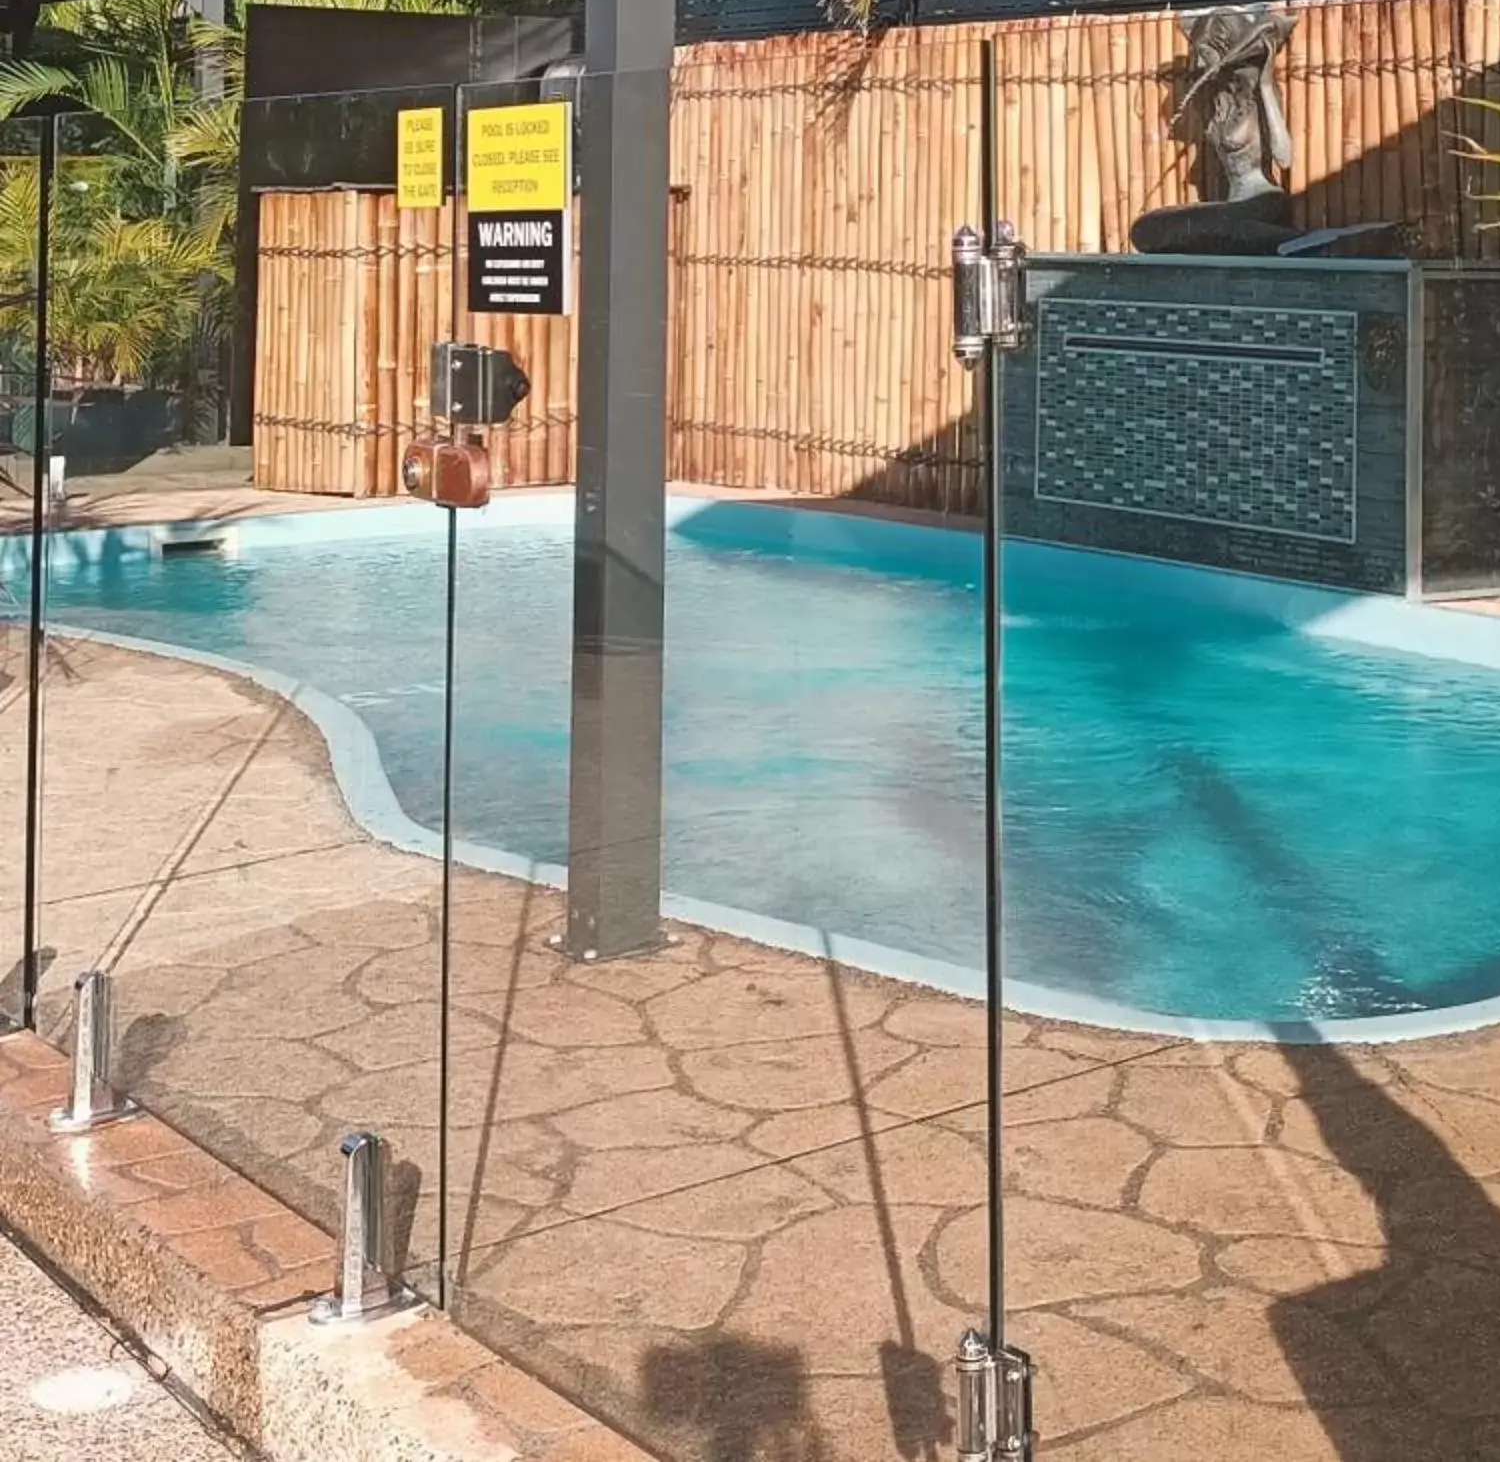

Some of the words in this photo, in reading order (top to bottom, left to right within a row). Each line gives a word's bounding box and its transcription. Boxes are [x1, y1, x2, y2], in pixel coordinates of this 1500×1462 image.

[481, 122, 503, 137] POOL
[505, 121, 514, 137] IS
[516, 119, 549, 136] LOCKED
[509, 149, 540, 165] PLEASE
[543, 148, 560, 163] SEE
[491, 178, 539, 194] RECEPTION
[478, 221, 553, 247] WARNING
